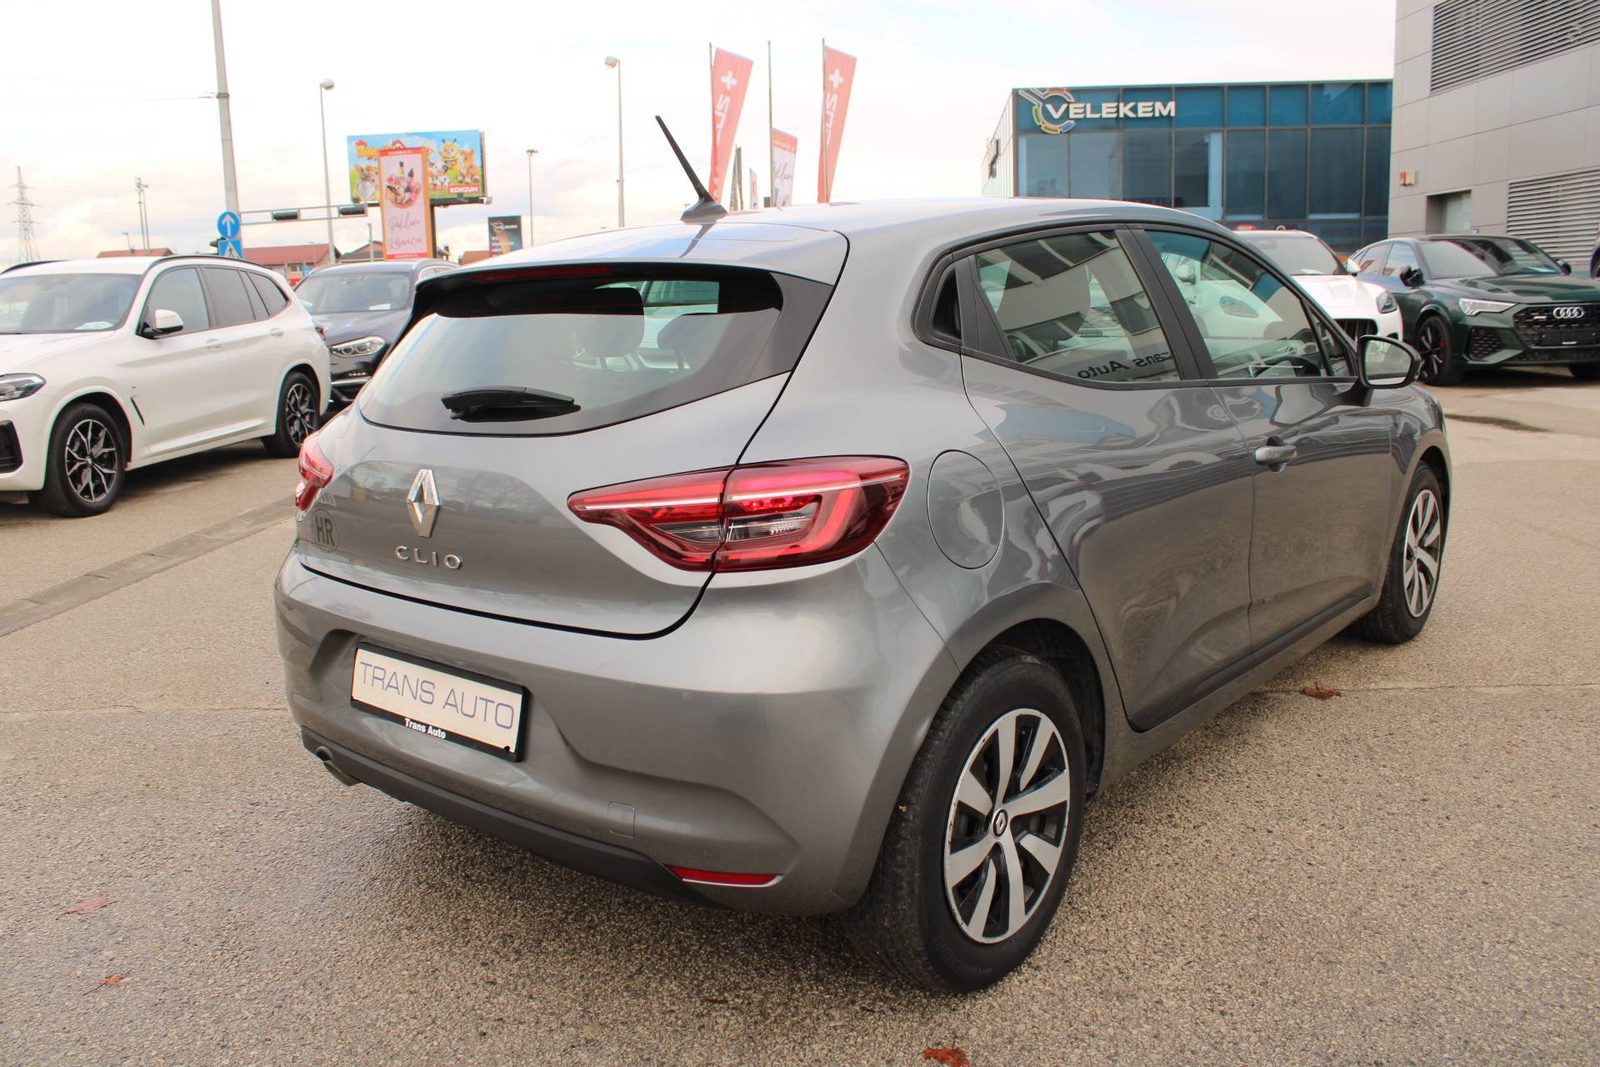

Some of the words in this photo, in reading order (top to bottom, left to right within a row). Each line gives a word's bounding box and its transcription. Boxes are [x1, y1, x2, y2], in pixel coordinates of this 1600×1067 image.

[1045, 101, 1176, 119] VELEKEM
[315, 515, 335, 547] HR
[395, 545, 463, 570] CLIO
[360, 661, 436, 705] TRANS
[443, 688, 514, 730] AUTO
[405, 717, 427, 734] Trans
[427, 725, 447, 739] Auto
